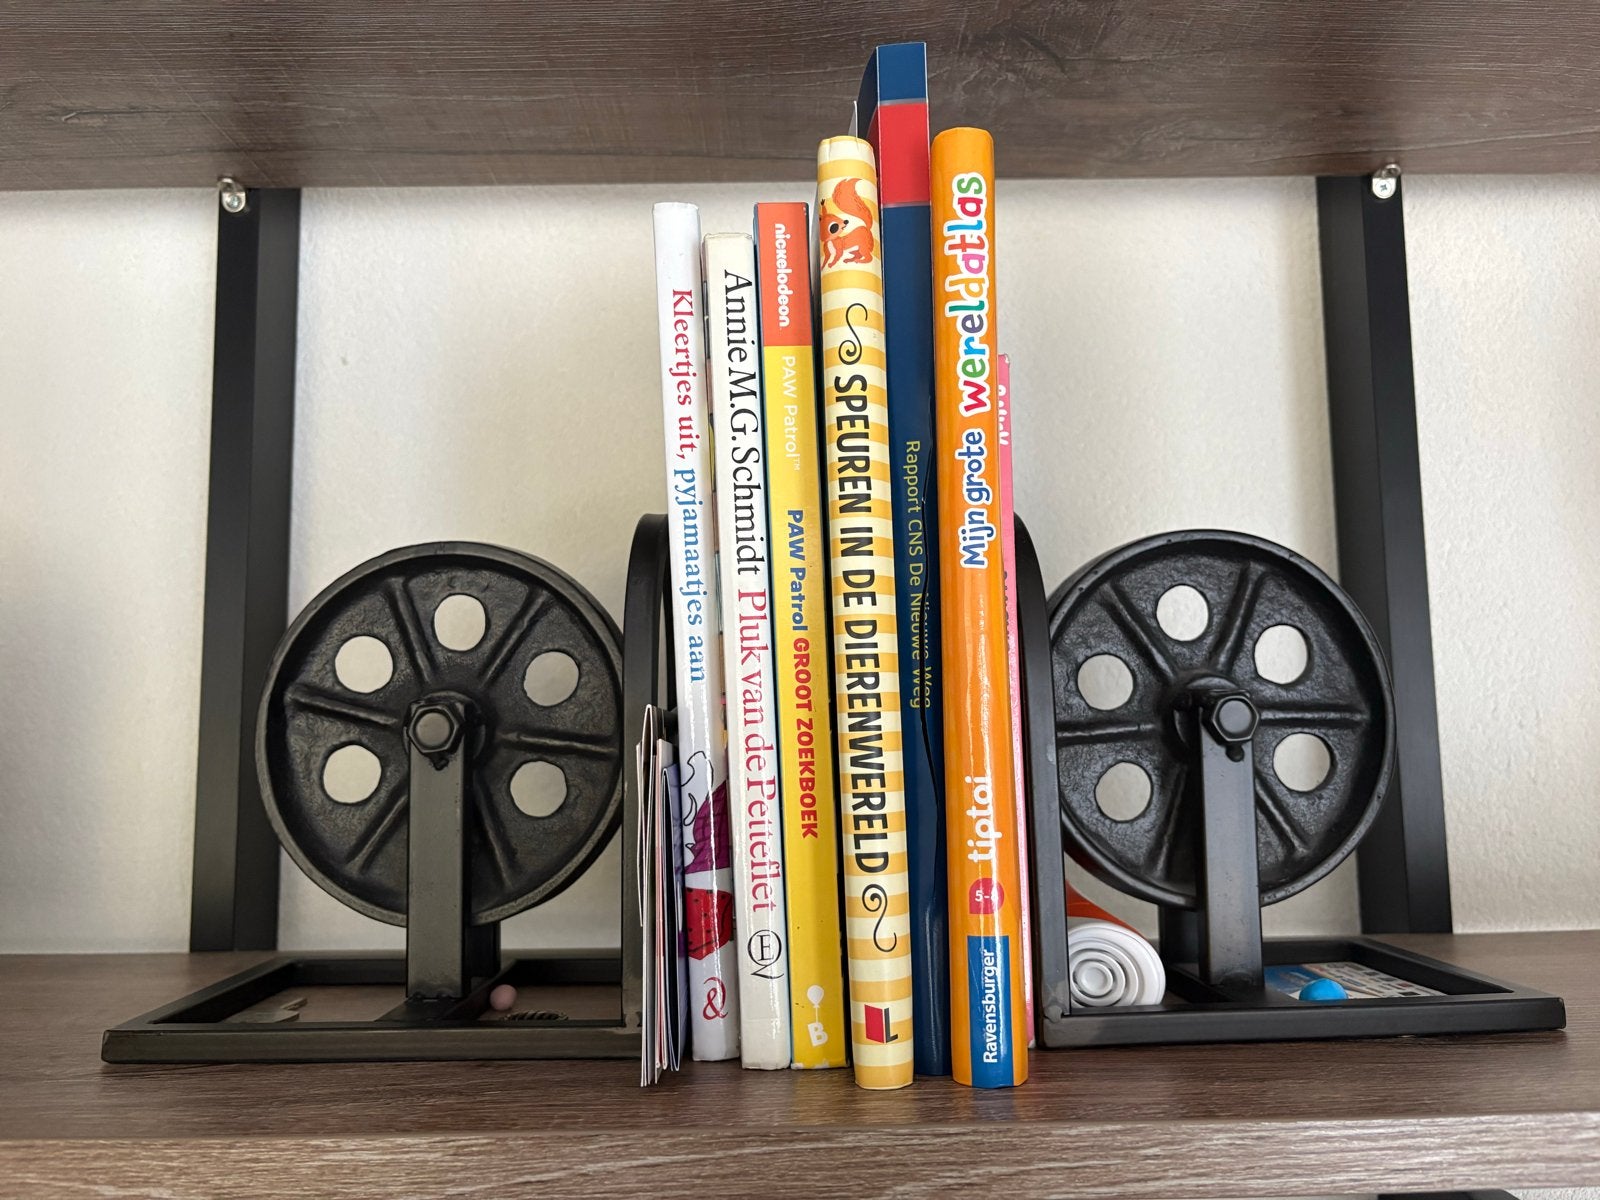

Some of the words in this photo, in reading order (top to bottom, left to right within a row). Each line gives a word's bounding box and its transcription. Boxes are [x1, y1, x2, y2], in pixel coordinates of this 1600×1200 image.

[775, 223, 793, 327] nickelodeon
[945, 175, 990, 413] wereldatlas
[668, 289, 697, 405] Kleertjes
[724, 269, 756, 363] Annie
[782, 356, 797, 398] PAW
[676, 416, 700, 459] uit,
[834, 374, 872, 513] SPEUREN
[957, 431, 990, 502] grote
[731, 446, 765, 575] Schmidt
[902, 440, 920, 513] Rapport
[674, 469, 708, 625] pyjamaatjes
[787, 510, 806, 561] PAW
[840, 526, 874, 557] IN
[908, 520, 923, 556] CNS
[962, 511, 994, 567] Mijn
[789, 567, 809, 631] Patrol
[842, 569, 877, 608] DE
[910, 562, 922, 586] De
[688, 636, 705, 683] aan
[737, 589, 769, 666] Pluk
[741, 670, 764, 727] van
[793, 638, 813, 712] GROOT
[745, 733, 775, 772] de
[796, 718, 818, 839] ZOEKBOEK
[844, 620, 889, 873] DIERENWERELD
[747, 775, 781, 912] Petteflet
[966, 776, 1002, 864] tiptoi
[982, 948, 999, 1064] Ravensburger
